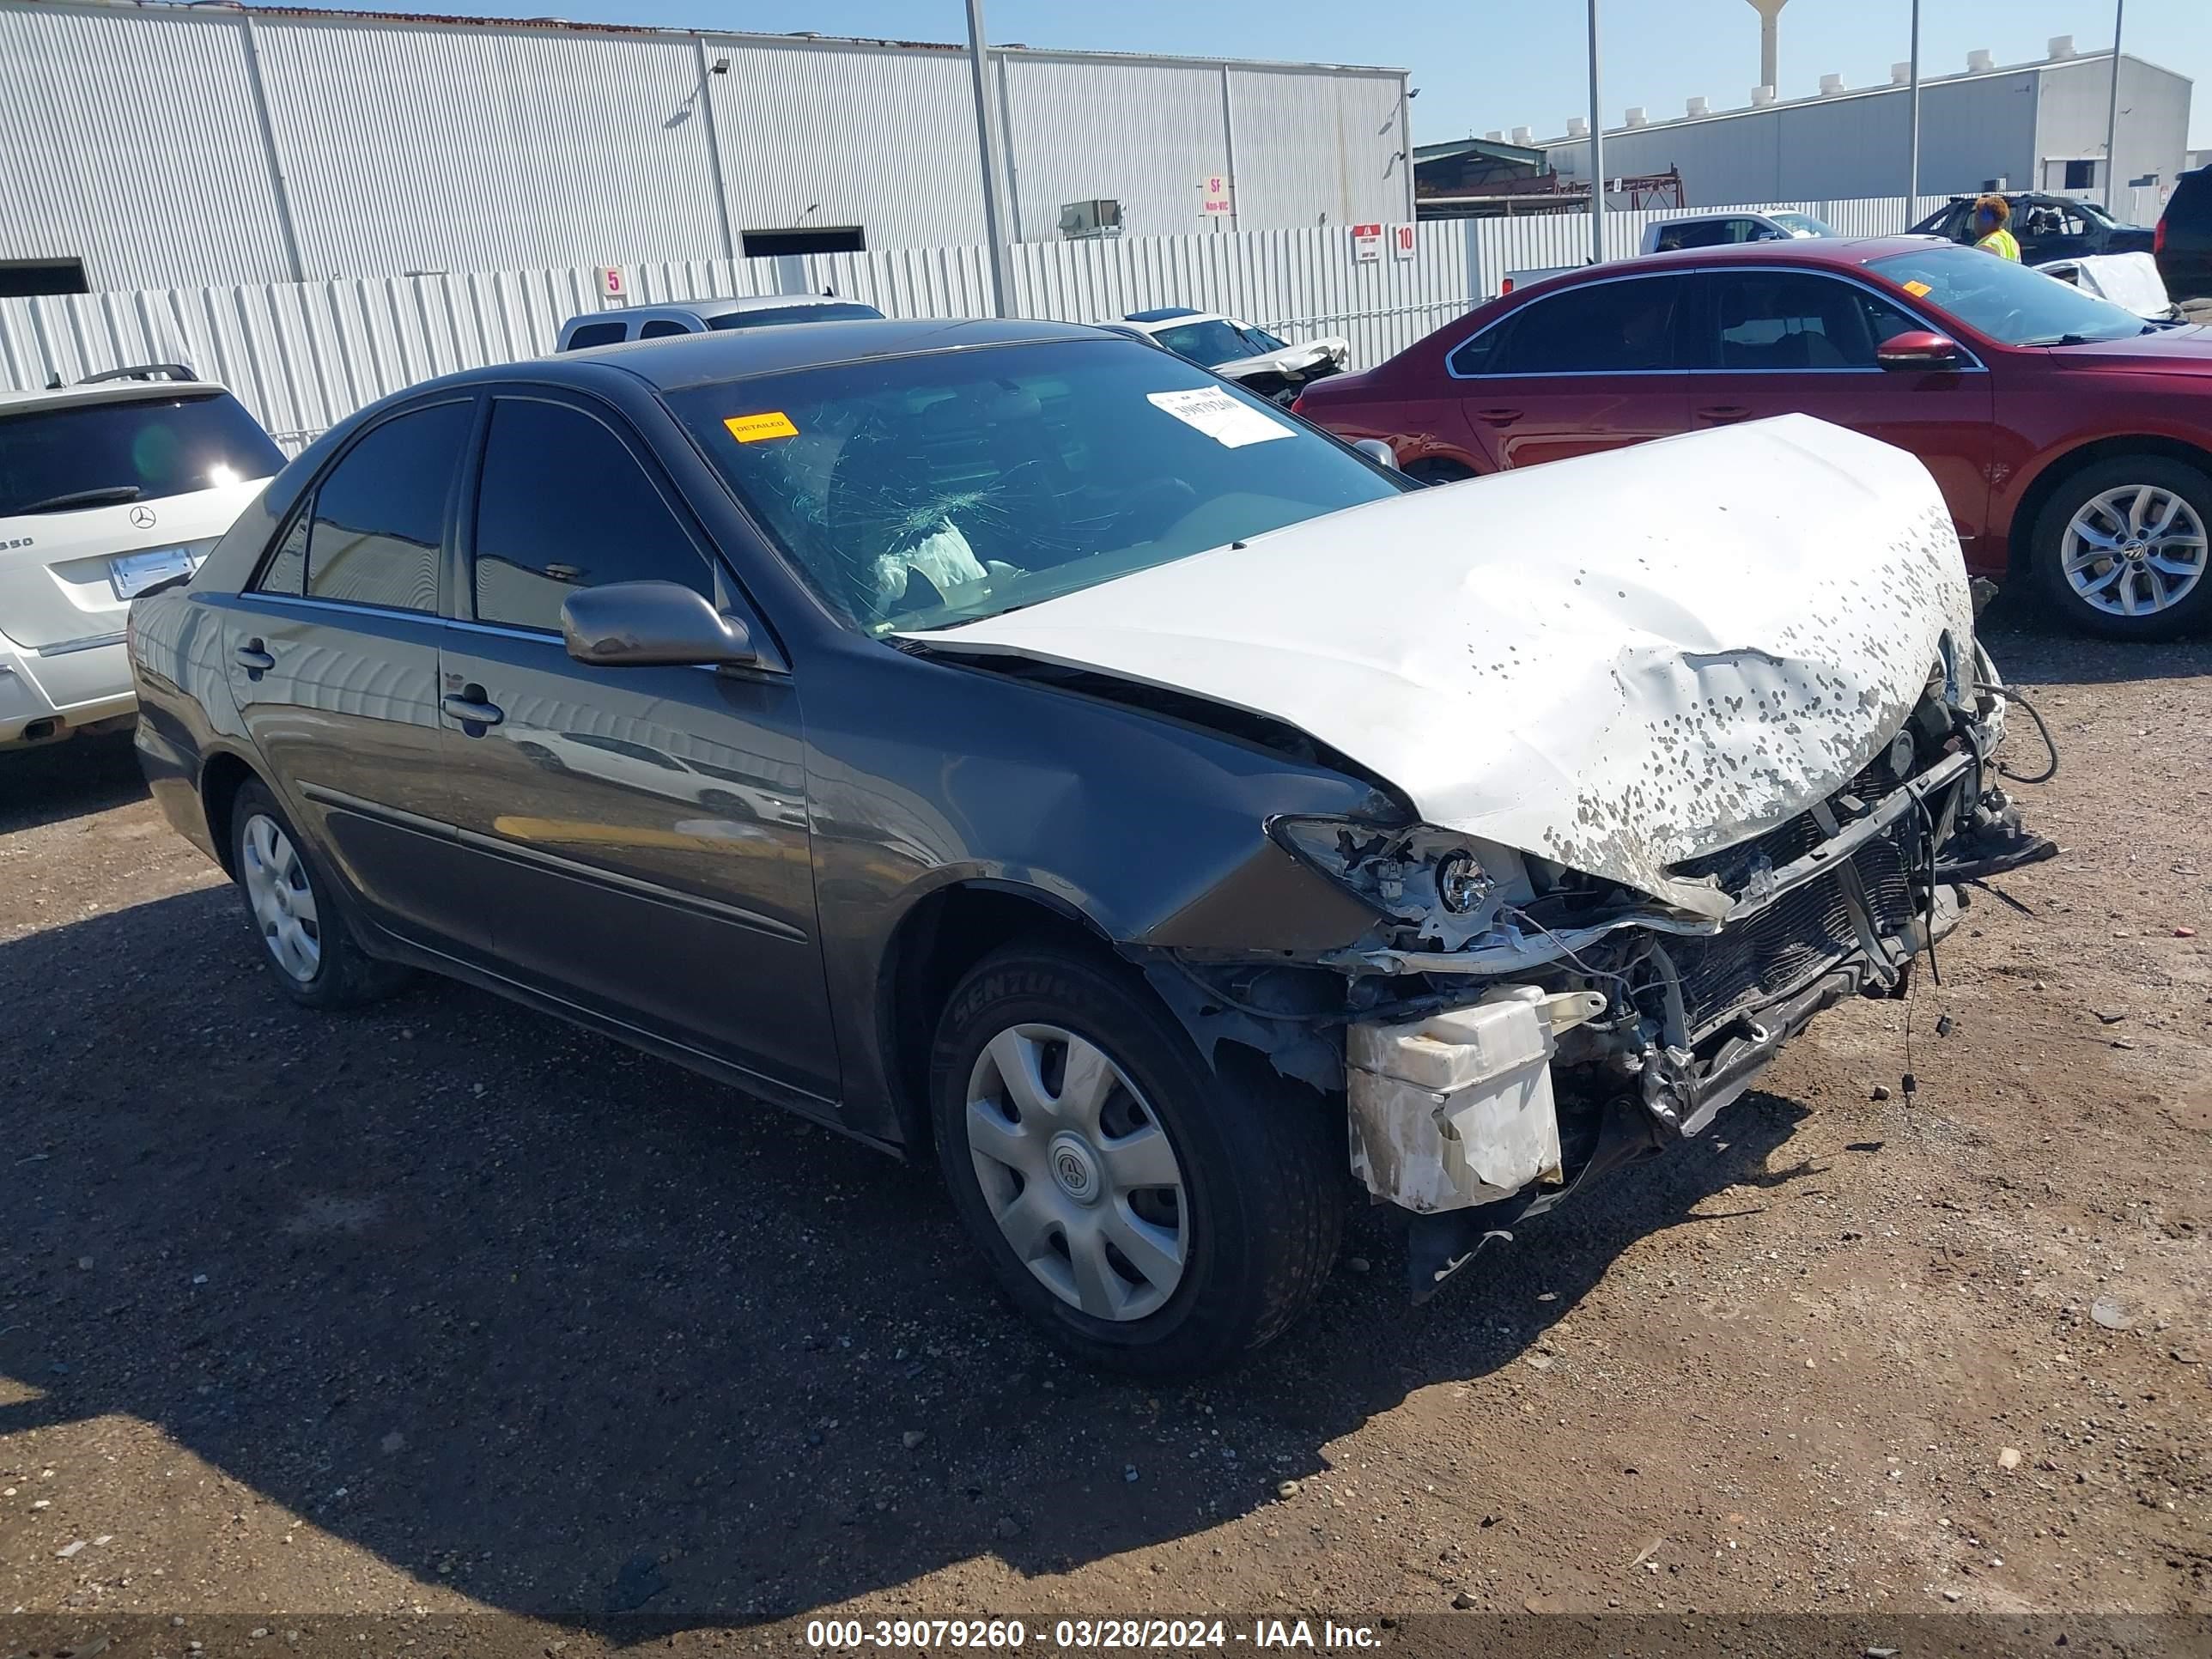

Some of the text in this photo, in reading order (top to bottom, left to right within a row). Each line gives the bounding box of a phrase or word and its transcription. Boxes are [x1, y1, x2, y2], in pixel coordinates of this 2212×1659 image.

[1211, 178, 1220, 193] SF
[1398, 227, 1413, 250] 10
[607, 271, 620, 290] 5
[736, 420, 785, 432] DETAILED
